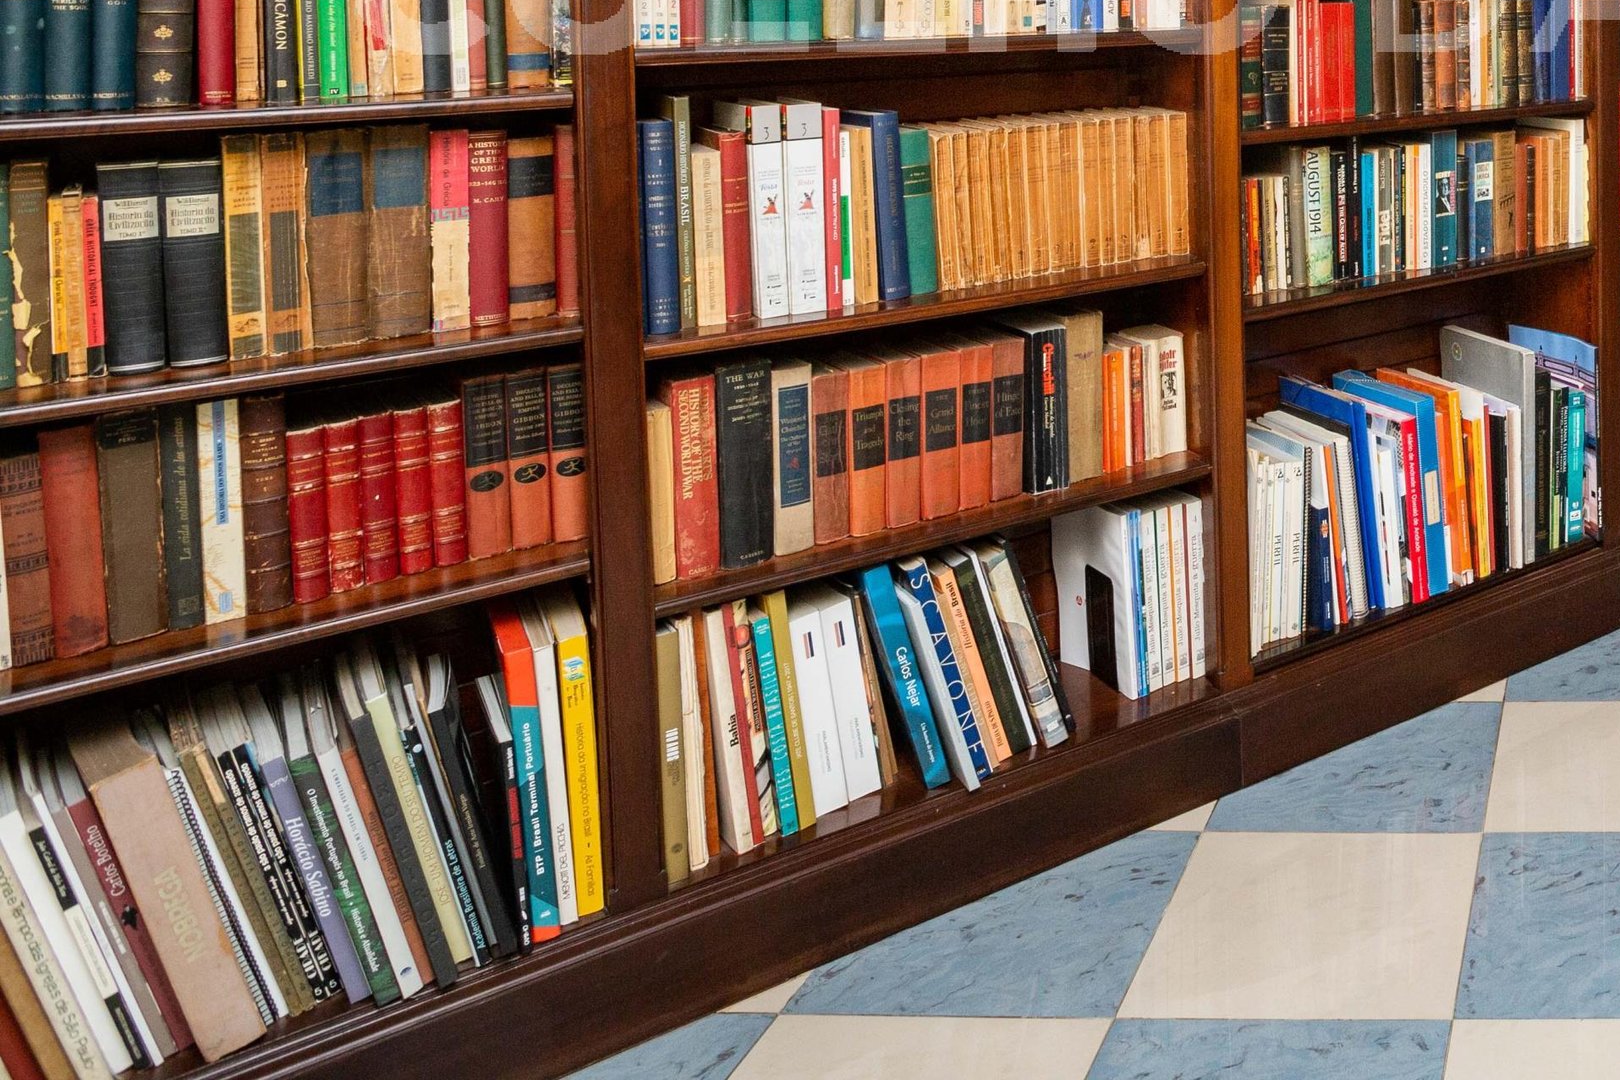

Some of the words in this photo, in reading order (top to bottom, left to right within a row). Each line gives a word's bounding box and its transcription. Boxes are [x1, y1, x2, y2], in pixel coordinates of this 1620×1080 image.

[1307, 151, 1320, 206] AUGUST
[680, 186, 690, 226] BRASIL
[85, 219, 95, 237] GREEK
[1309, 208, 1322, 234] 1914
[1379, 209, 1390, 245] Fidel
[86, 240, 96, 276] HISTORICAL
[88, 279, 98, 307] THOUGHT
[746, 369, 765, 379] WAR
[1042, 343, 1055, 395] Churchill
[513, 413, 545, 424] GIBBON
[678, 390, 690, 436] SECOND
[686, 388, 702, 438] HISTORY
[854, 410, 884, 422] Triumph
[889, 401, 919, 414] Closing
[898, 416, 911, 426] the
[931, 406, 955, 419] Grand
[690, 440, 703, 454] OF
[895, 430, 913, 443] Ring
[680, 435, 692, 477] WORLD
[692, 455, 704, 483] THE
[175, 465, 185, 476] de
[176, 480, 188, 520] cotidiana
[682, 477, 694, 500] WAR
[179, 524, 190, 543] vida
[180, 547, 191, 560] La
[946, 581, 959, 607] Brasil
[960, 619, 973, 649] História
[895, 646, 912, 680] Carlos
[905, 679, 922, 707] Nejar
[726, 714, 739, 747] Bahia
[521, 722, 535, 770] Portuário
[225, 769, 244, 798] azevedo
[241, 762, 260, 790] azevedo
[526, 771, 539, 815] Terminal
[239, 805, 254, 826] ramos
[255, 798, 270, 820] ramos
[85, 824, 112, 865] Botelho
[250, 835, 267, 854] paulo
[265, 828, 283, 847] paulo
[530, 818, 542, 848] Brasil
[258, 854, 270, 865] são
[274, 846, 286, 858] são
[444, 839, 459, 865] Letras
[535, 855, 545, 875] BTP
[560, 854, 570, 870] DEL
[99, 864, 126, 896] Carlos
[285, 817, 317, 871] Horácio
[303, 871, 332, 918] Sabino
[452, 865, 463, 876] de
[310, 796, 332, 837] Investimento
[323, 838, 342, 871] Português
[338, 880, 352, 899] Brasil
[361, 940, 380, 973] Atualidade
[456, 876, 475, 913] Brasileira
[467, 912, 486, 949] Academia
[293, 936, 317, 979] CIDADE
[311, 930, 332, 971] CIDADE
[54, 1001, 71, 1016] de
[61, 1014, 82, 1039] São
[74, 1039, 95, 1070] Paulo
